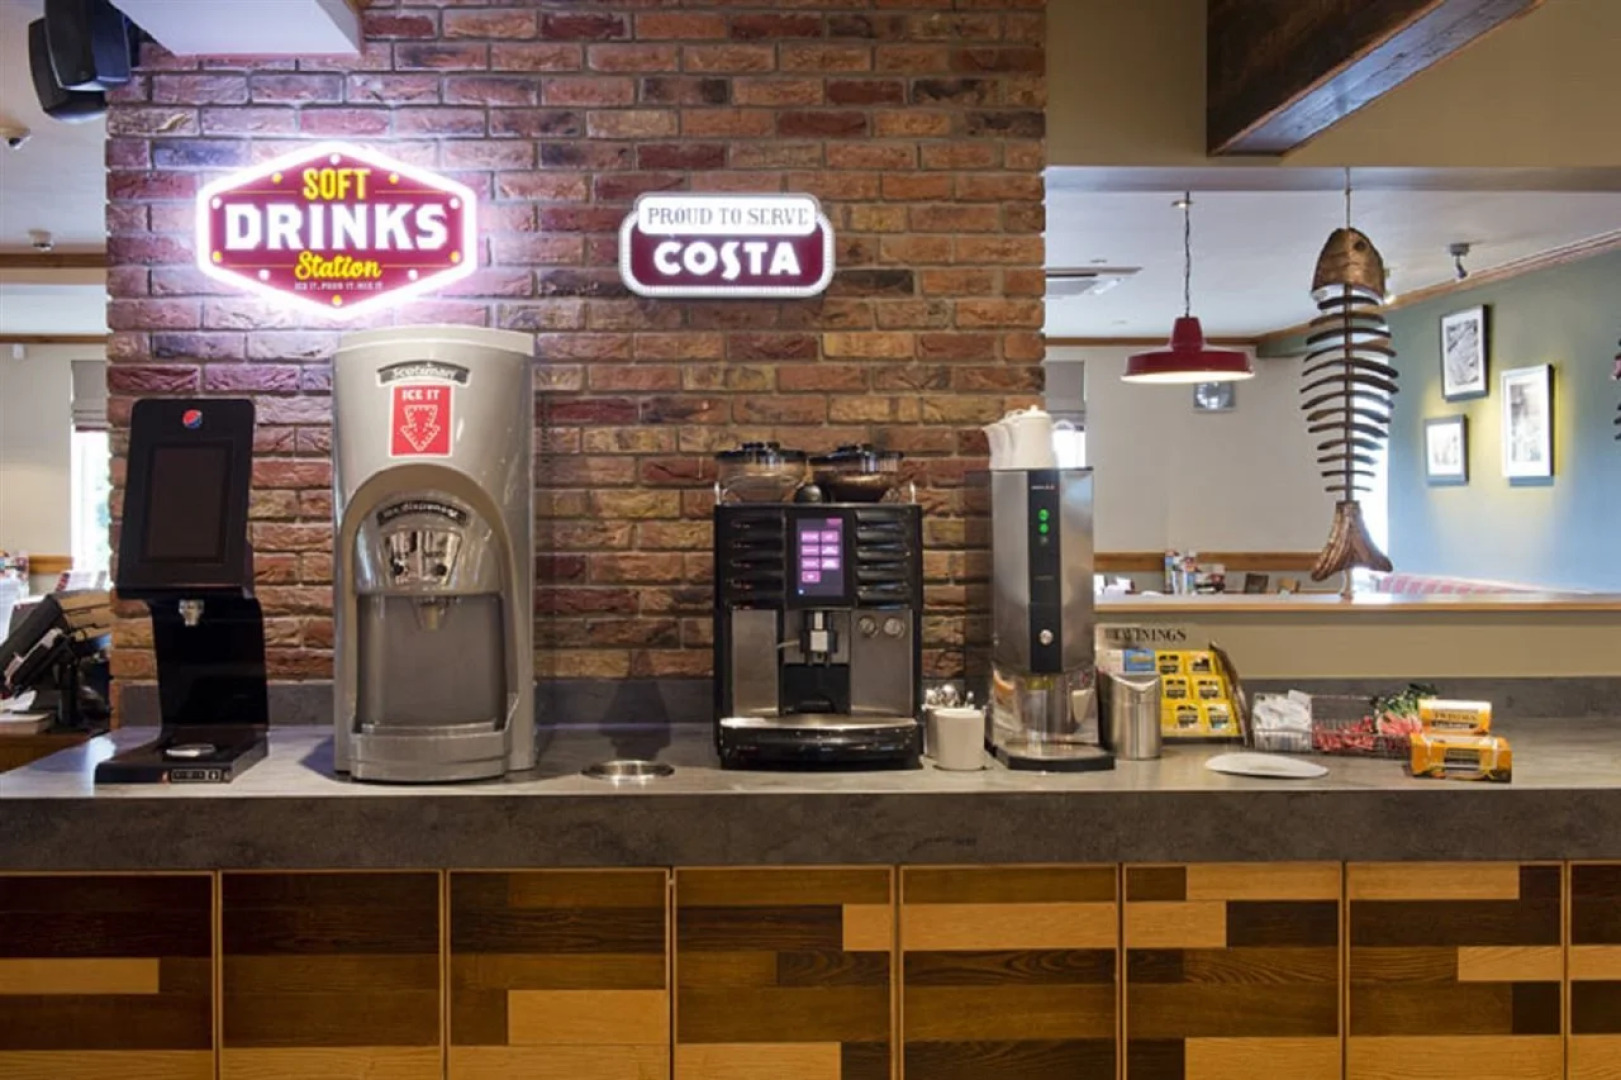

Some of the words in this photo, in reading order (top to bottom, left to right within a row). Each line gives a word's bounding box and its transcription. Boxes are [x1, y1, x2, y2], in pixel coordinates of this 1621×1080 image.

[303, 168, 370, 200] SOFT
[225, 203, 448, 250] DRINKS
[648, 207, 713, 225] PROUD
[718, 207, 742, 225] TO
[747, 207, 808, 225] SERVE
[295, 251, 382, 280] Station
[653, 241, 801, 280] COSTA
[402, 390, 423, 400] ICE
[427, 390, 440, 400] IT
